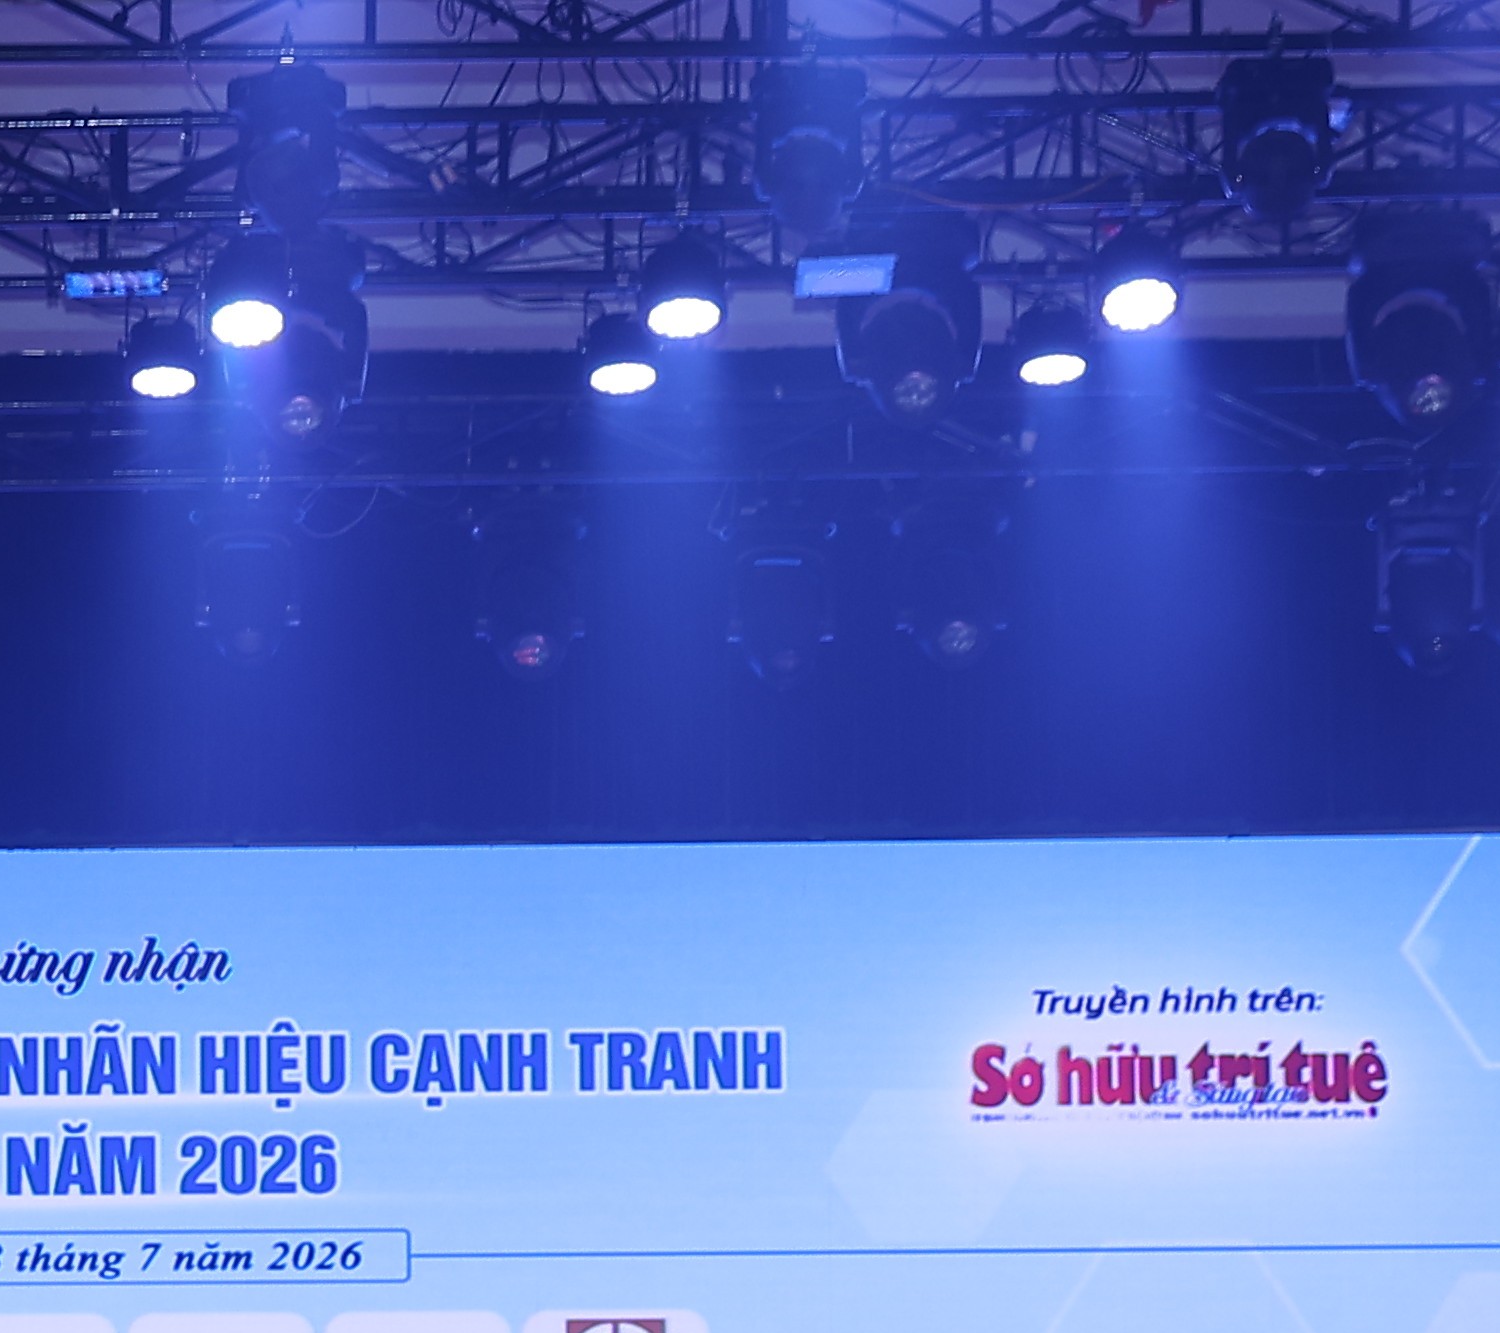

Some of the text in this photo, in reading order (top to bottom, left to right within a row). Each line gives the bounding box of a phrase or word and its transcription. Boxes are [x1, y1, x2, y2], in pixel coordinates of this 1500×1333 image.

[104, 936, 232, 991] nhận
[1033, 985, 1325, 1019] Truyền hình trên:
[201, 1022, 347, 1107] HIỆU
[369, 1031, 548, 1107] CẠNH
[571, 1030, 785, 1091] TRANH
[1057, 1043, 1177, 1105] hữu
[1187, 1040, 1273, 1103] trí
[1279, 1039, 1388, 1118] tuệ
[6, 1120, 157, 1196] NĂM
[180, 1134, 338, 1196] 2026
[14, 1243, 126, 1280] tháng
[140, 1242, 162, 1272] 7
[172, 1242, 254, 1272] năm
[266, 1240, 363, 1271] 2026
